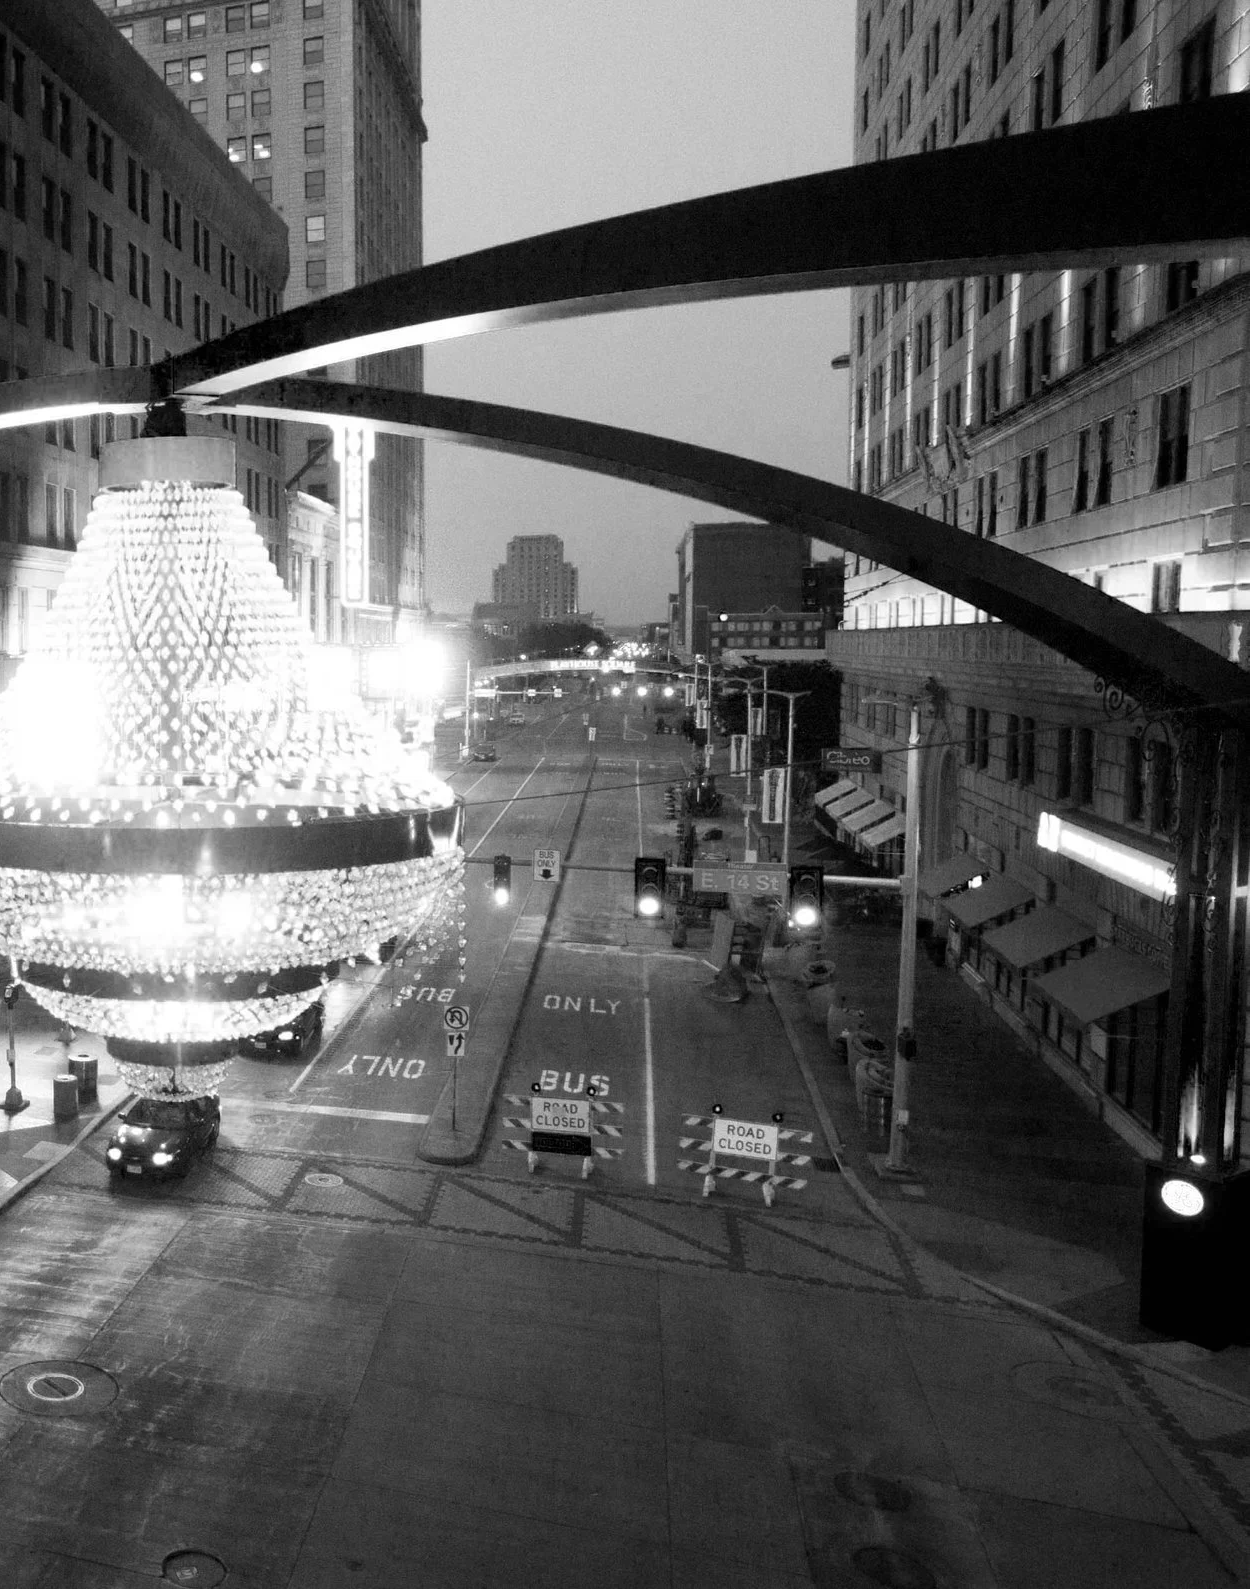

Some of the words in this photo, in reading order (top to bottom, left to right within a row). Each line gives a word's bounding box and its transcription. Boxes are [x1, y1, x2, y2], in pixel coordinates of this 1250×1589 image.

[537, 859, 556, 868] ONLY
[539, 850, 555, 859] BUS
[701, 872, 718, 889] E.
[726, 874, 750, 890] 14
[755, 874, 780, 891] St
[397, 984, 456, 1003] BUS
[543, 994, 622, 1016] ONLY
[337, 1054, 426, 1079] ONLY
[539, 1069, 611, 1096] BUS
[535, 1114, 586, 1129] CLOSED
[727, 1124, 765, 1139] ROAD
[718, 1137, 772, 1155] CLOSED
